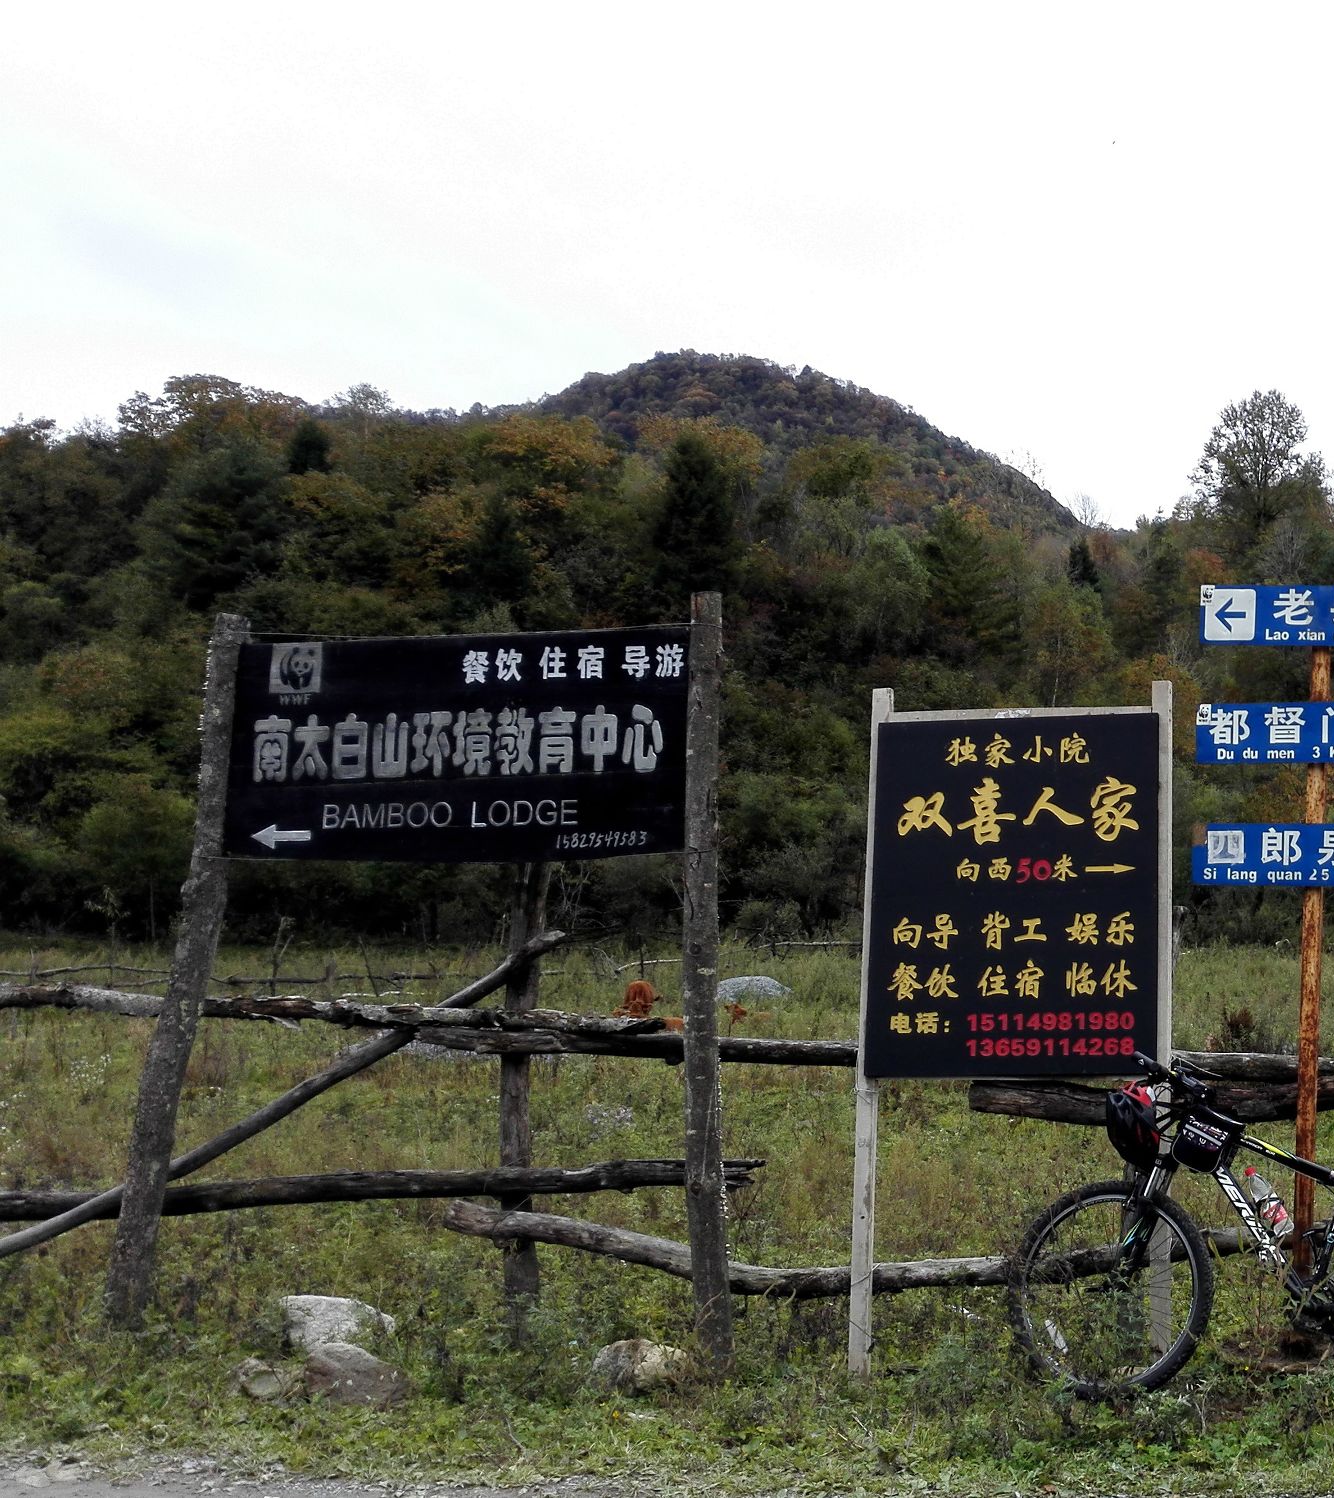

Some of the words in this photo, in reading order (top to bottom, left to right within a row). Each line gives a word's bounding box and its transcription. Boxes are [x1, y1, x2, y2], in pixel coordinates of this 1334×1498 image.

[1265, 628, 1290, 641] Lao
[1298, 631, 1326, 641] xian
[462, 648, 523, 684] 餐饮
[539, 644, 605, 680] 住宿
[621, 643, 684, 678] 导游
[278, 694, 312, 706] WWF
[253, 703, 664, 783] 南太白山环境教育中心
[945, 731, 1090, 769] 独家小院
[1217, 748, 1234, 760] Du
[1242, 747, 1259, 760] du
[1267, 749, 1295, 759] men
[1312, 746, 1321, 759] 3
[321, 801, 453, 830] BAMBOO
[470, 799, 579, 829] LODGE
[897, 776, 1140, 846] 双喜人家
[555, 829, 649, 850] 15829549583
[954, 855, 1079, 884] 向西50米
[1203, 867, 1217, 880] Si
[1227, 867, 1257, 883] lang
[1267, 871, 1302, 883] quan
[892, 913, 959, 950] 向导
[980, 910, 1048, 951] 背工
[1064, 911, 1135, 946] 娱乐
[886, 962, 959, 1001] 餐饮
[976, 959, 1045, 999] 住宿
[1065, 959, 1138, 998] 临休
[967, 1011, 1135, 1032] 15114981980
[966, 1036, 1138, 1057] 13659114268
